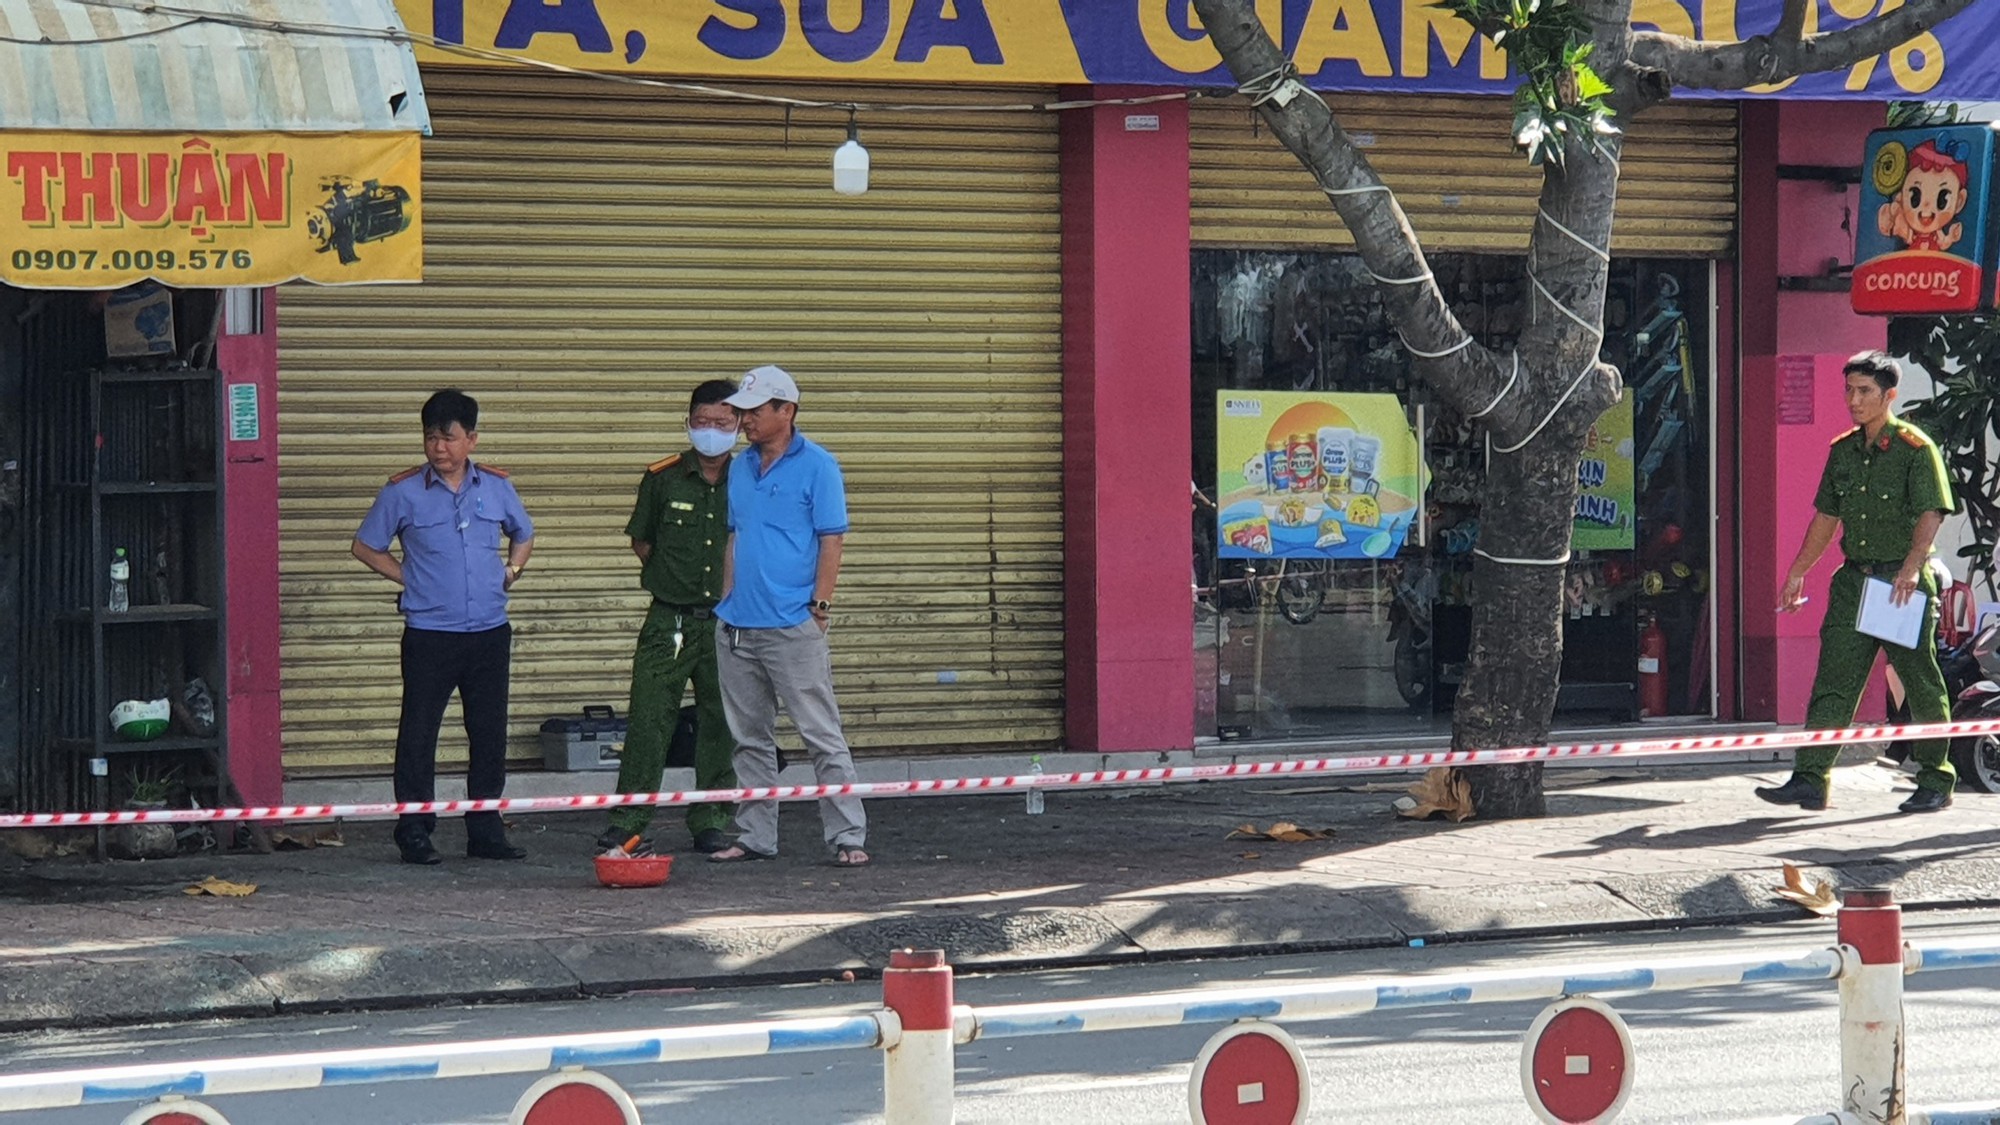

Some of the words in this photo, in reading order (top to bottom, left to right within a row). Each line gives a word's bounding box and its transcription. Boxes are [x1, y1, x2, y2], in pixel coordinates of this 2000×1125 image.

[8, 138, 288, 237] THUẬN
[11, 249, 252, 271] 0907.009.576
[1575, 493, 1617, 523] INH
